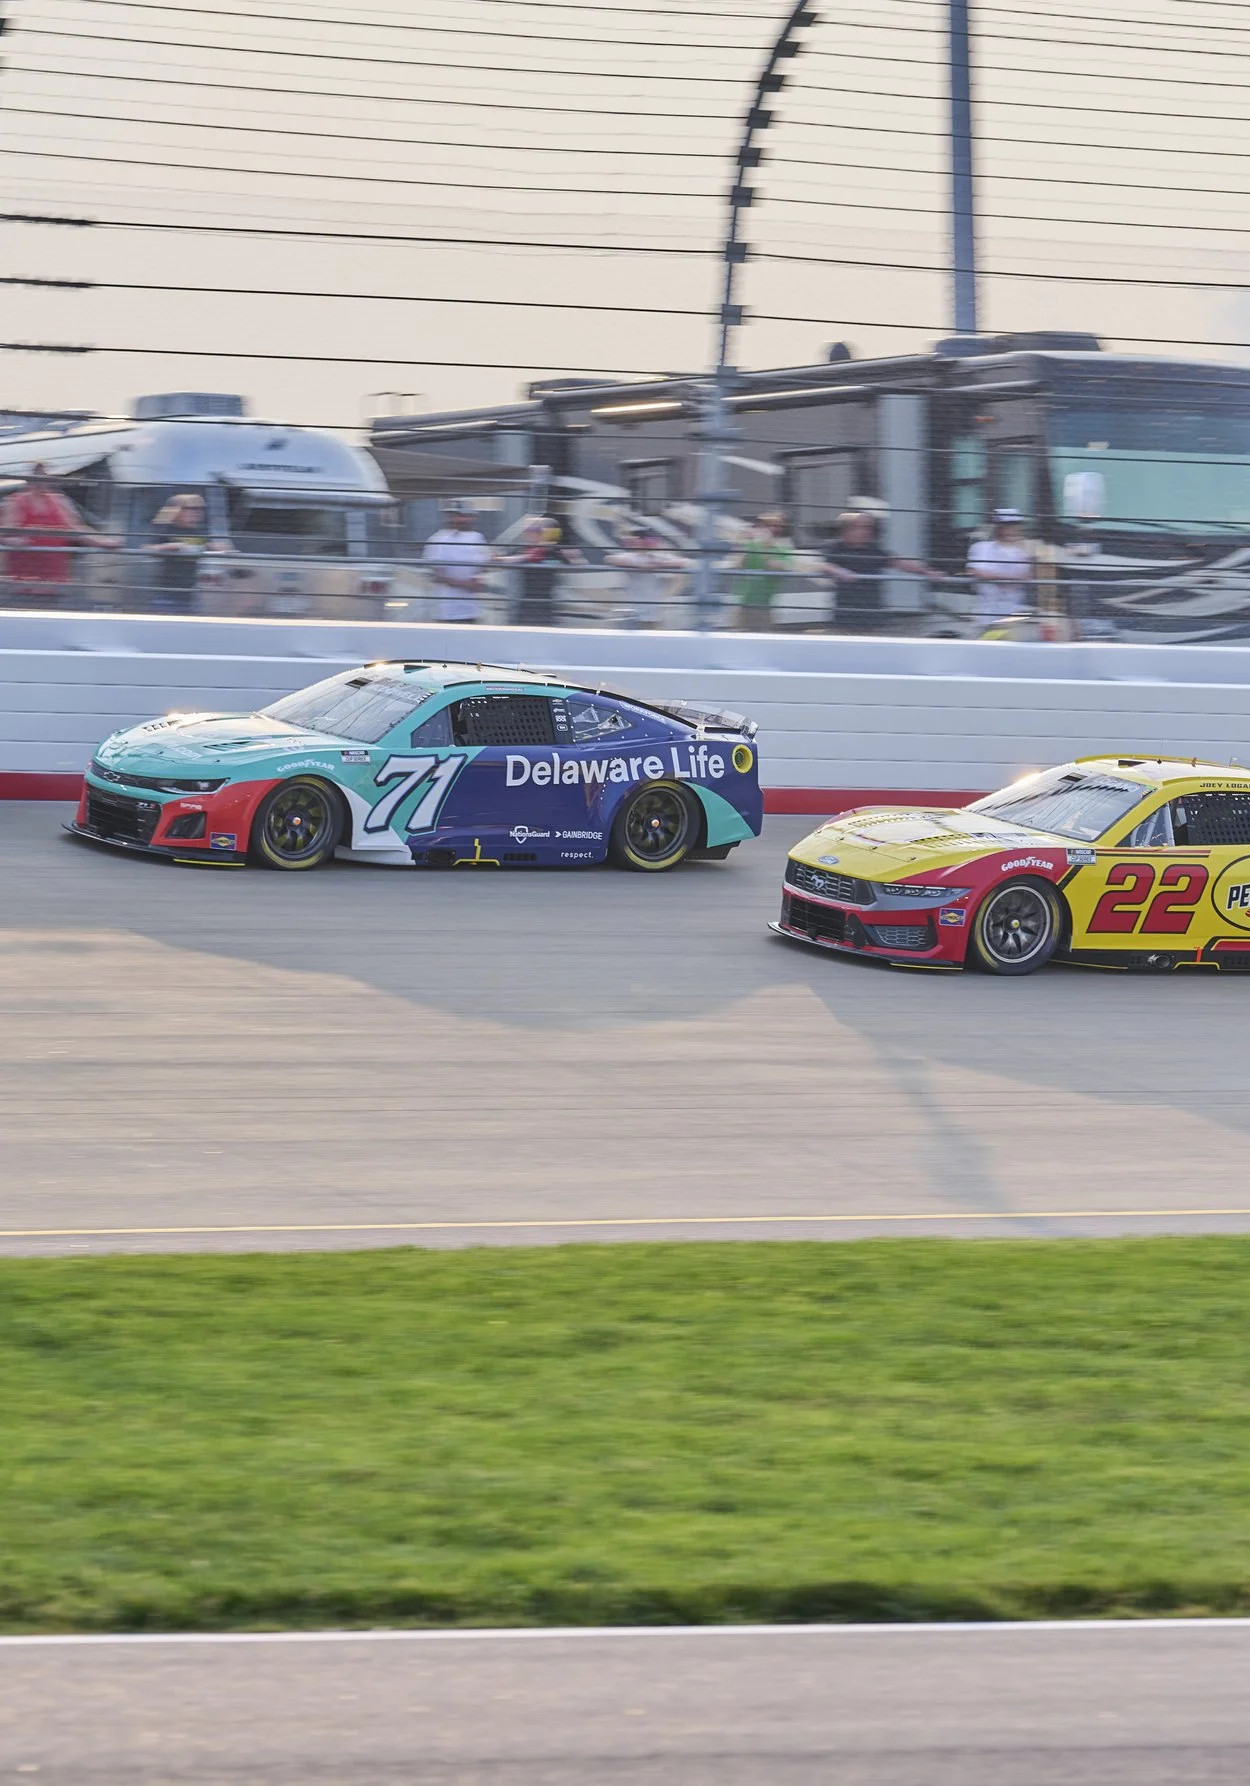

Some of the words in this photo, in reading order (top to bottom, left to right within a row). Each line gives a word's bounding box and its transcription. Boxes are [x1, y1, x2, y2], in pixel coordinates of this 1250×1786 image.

[276, 759, 336, 772] GOODYEAR
[506, 753, 665, 787] Delaware
[671, 745, 725, 779] Life
[364, 754, 468, 836] 71
[509, 830, 551, 838] NationsGuard
[562, 830, 604, 840] GAINBRIDGE
[1001, 856, 1054, 872] GOODYEAR
[1085, 862, 1209, 934] 22
